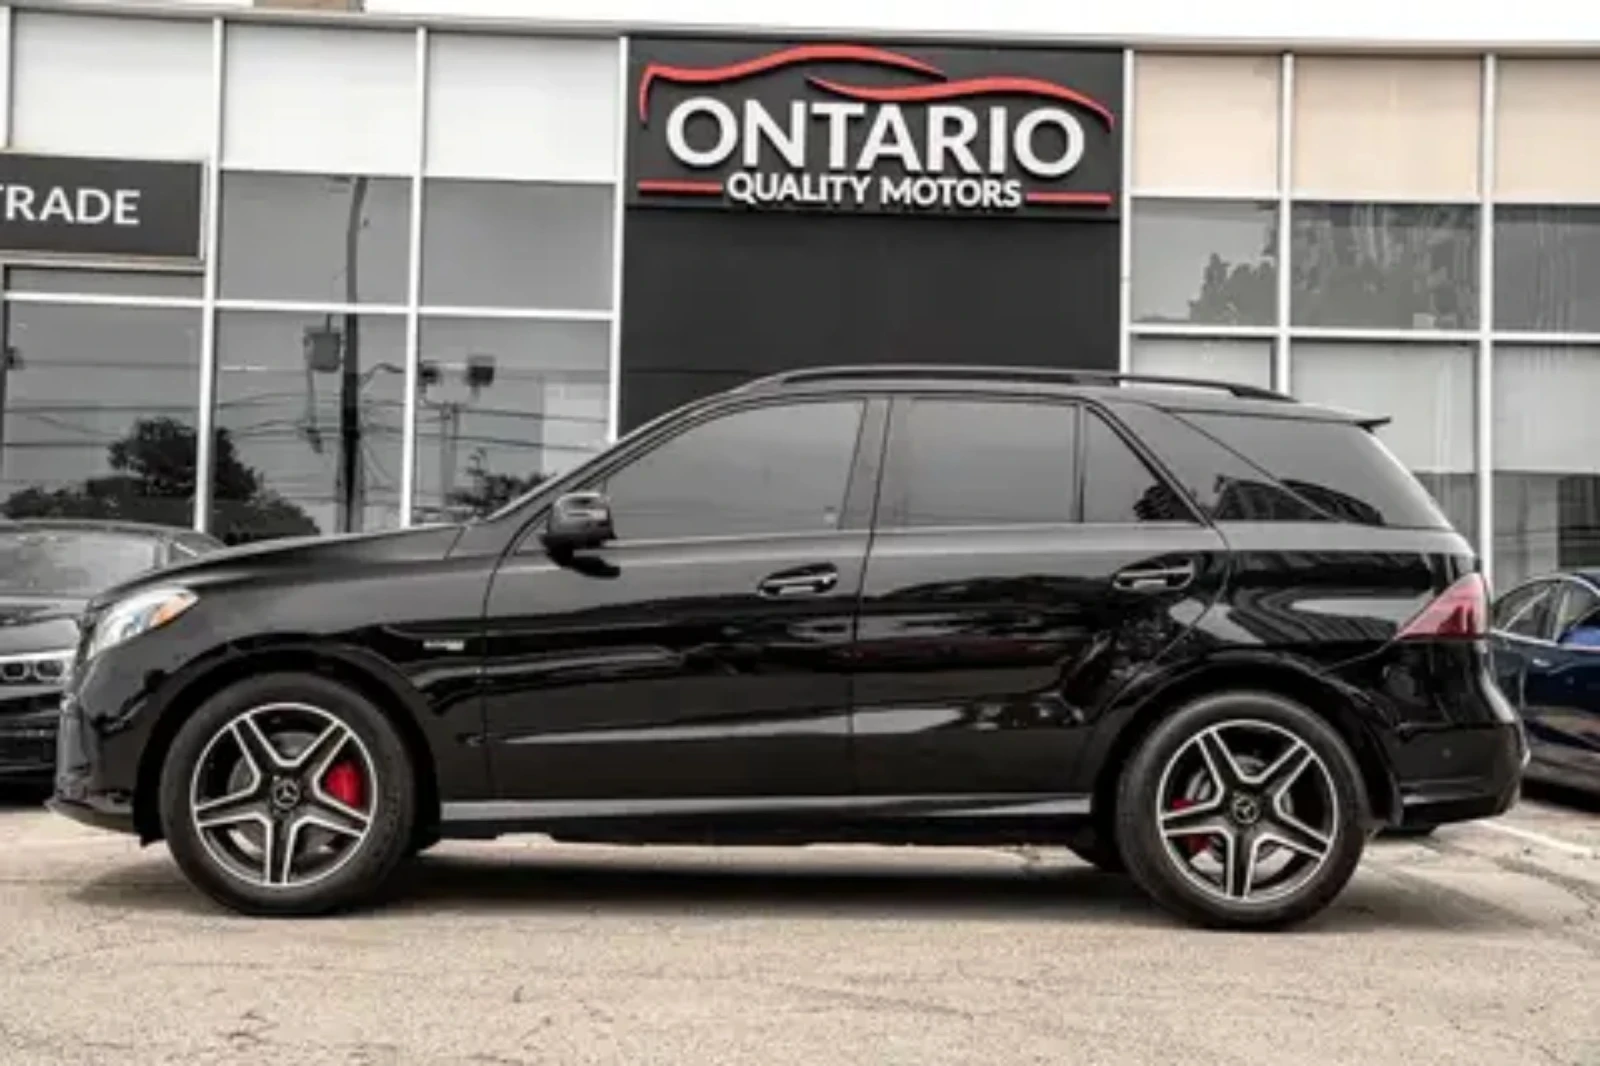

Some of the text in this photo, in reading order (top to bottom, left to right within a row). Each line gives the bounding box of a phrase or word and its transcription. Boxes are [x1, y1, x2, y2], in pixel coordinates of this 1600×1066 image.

[666, 97, 1085, 178] ONTARIO
[0, 184, 141, 225] RADE
[727, 172, 1021, 208] QUALITY MOTORS
